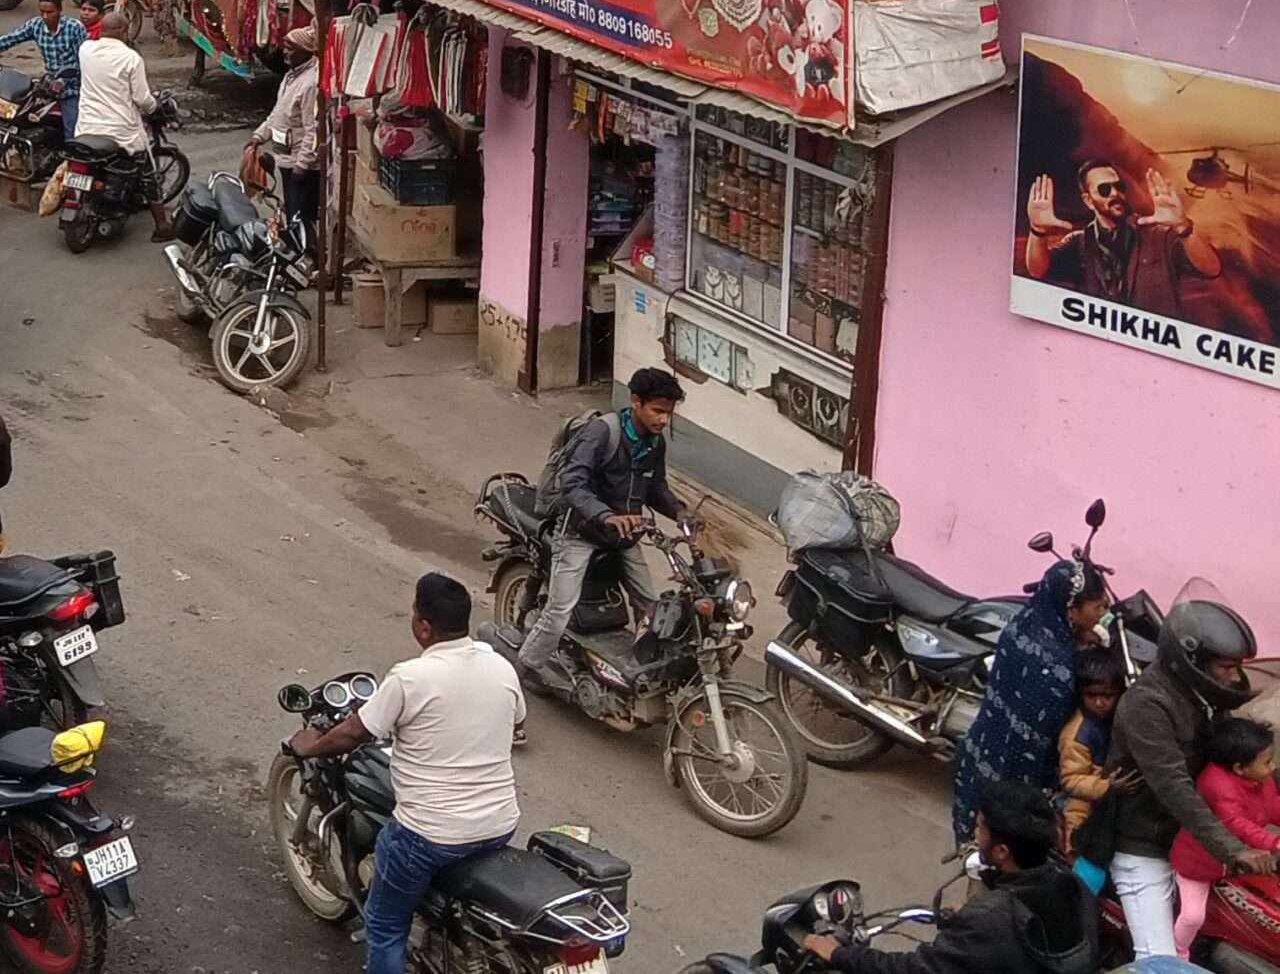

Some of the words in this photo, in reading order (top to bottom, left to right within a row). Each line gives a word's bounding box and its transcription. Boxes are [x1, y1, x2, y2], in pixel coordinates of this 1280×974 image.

[598, 10, 673, 50] 8809168055
[1061, 297, 1181, 350] SHIKHA
[1195, 333, 1275, 375] CAKE
